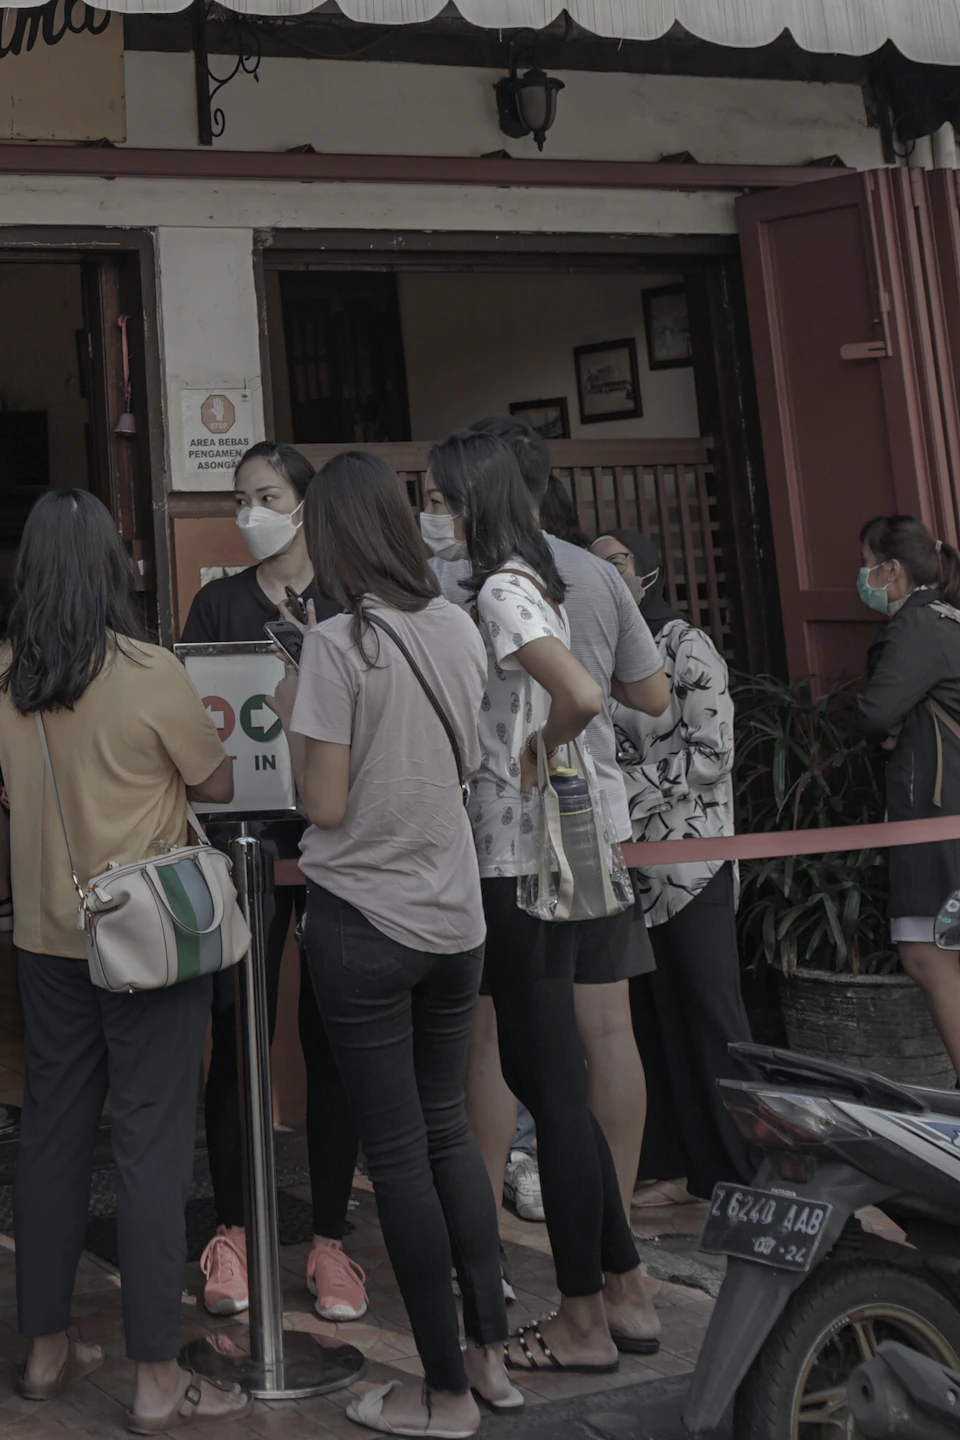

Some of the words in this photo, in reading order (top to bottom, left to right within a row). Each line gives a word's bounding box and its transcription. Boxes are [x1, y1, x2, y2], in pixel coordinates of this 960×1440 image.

[190, 439, 216, 447] AREA
[218, 438, 249, 446] BEBAS
[189, 450, 241, 458] PENGAMEN
[254, 754, 277, 771] IN
[770, 1187, 797, 1197] HONDA
[712, 1190, 726, 1216] Z
[727, 1192, 776, 1224] 6240
[783, 1204, 823, 1235] AAB
